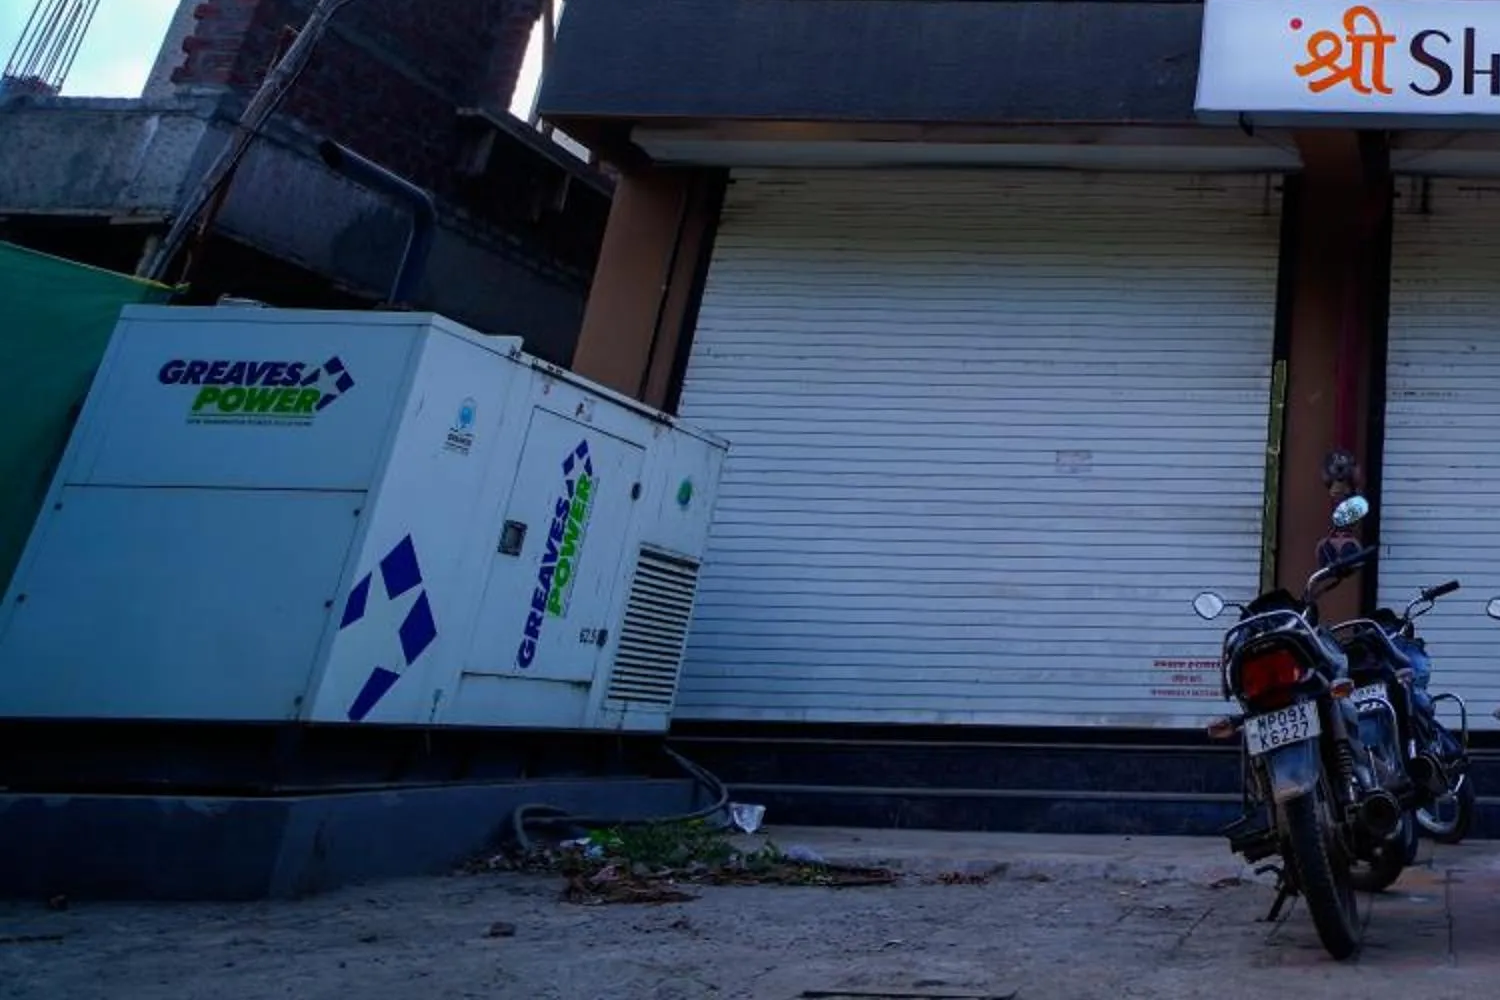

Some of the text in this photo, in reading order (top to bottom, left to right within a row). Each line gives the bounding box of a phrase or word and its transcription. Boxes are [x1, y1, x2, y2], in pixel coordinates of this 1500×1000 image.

[1294, 5, 1396, 96] श्री
[158, 359, 306, 386] GREAVES
[192, 386, 320, 412] POWER
[517, 497, 570, 668] GREAVES
[548, 473, 592, 616] POWER
